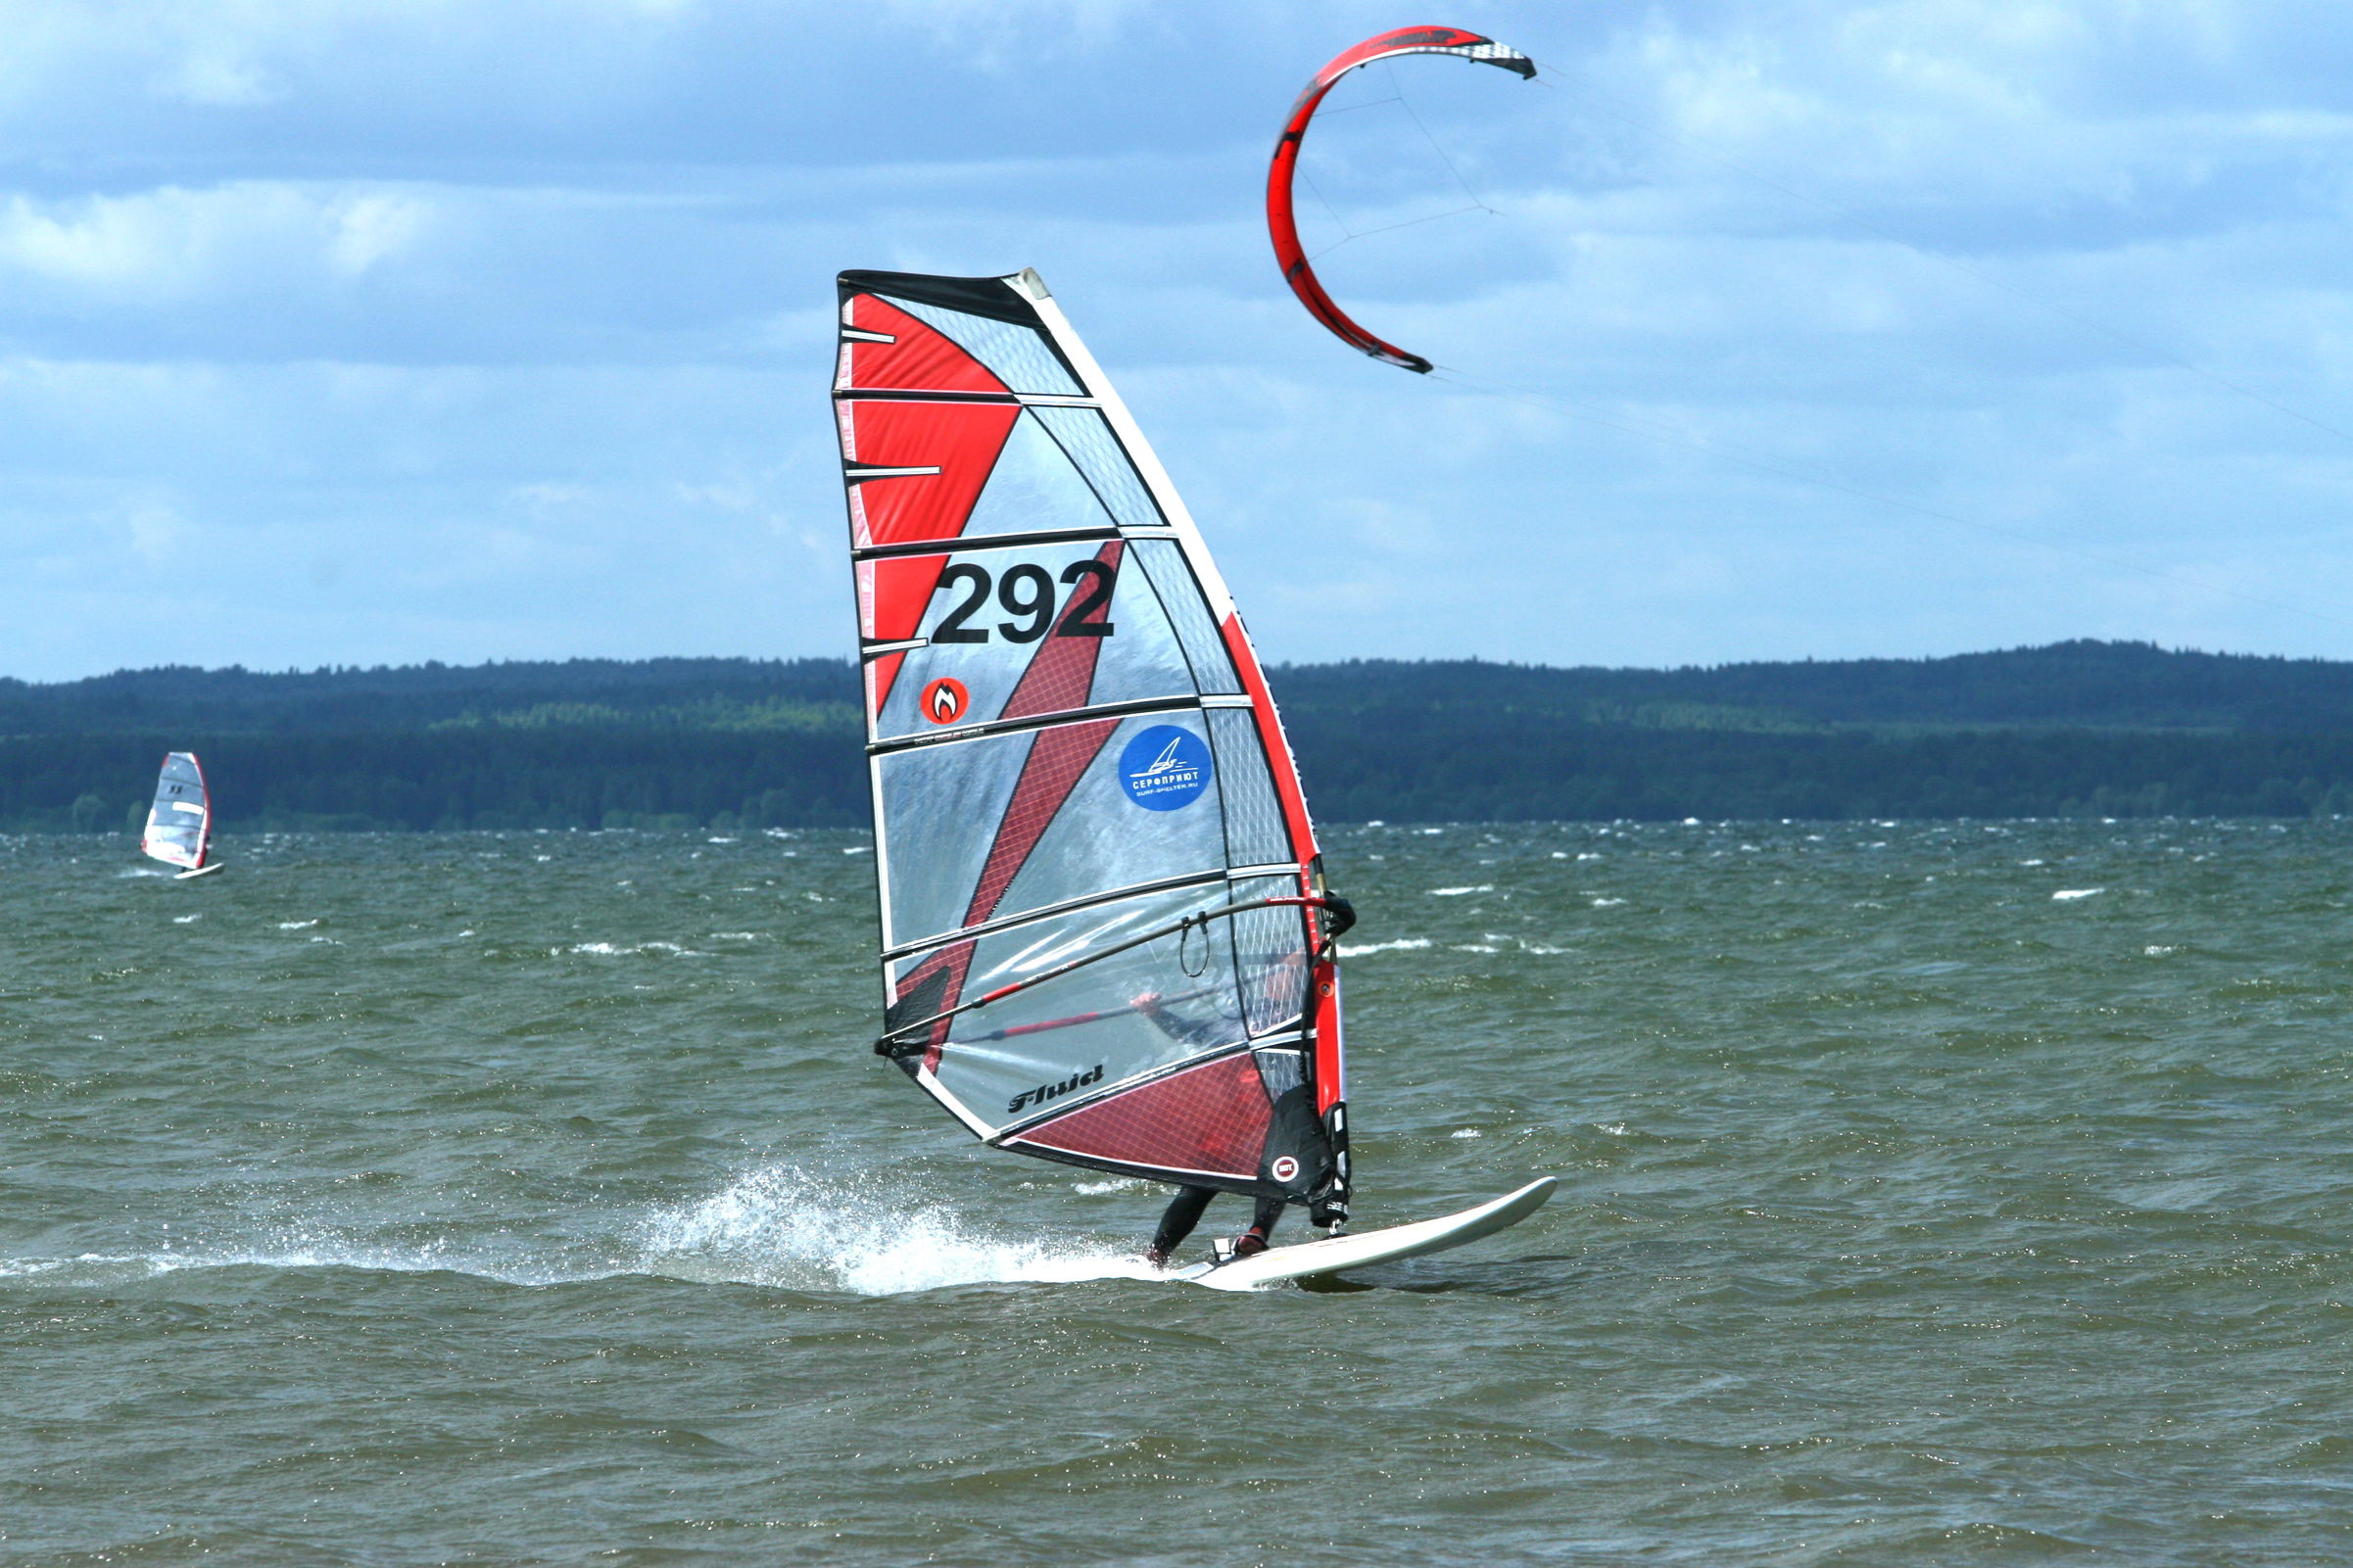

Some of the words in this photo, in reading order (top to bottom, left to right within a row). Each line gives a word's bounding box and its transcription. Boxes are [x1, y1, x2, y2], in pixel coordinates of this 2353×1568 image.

[931, 559, 1115, 643] 292
[1132, 772, 1199, 789] СЕРОПРИЮТ
[1008, 1065, 1105, 1114] Fluid
